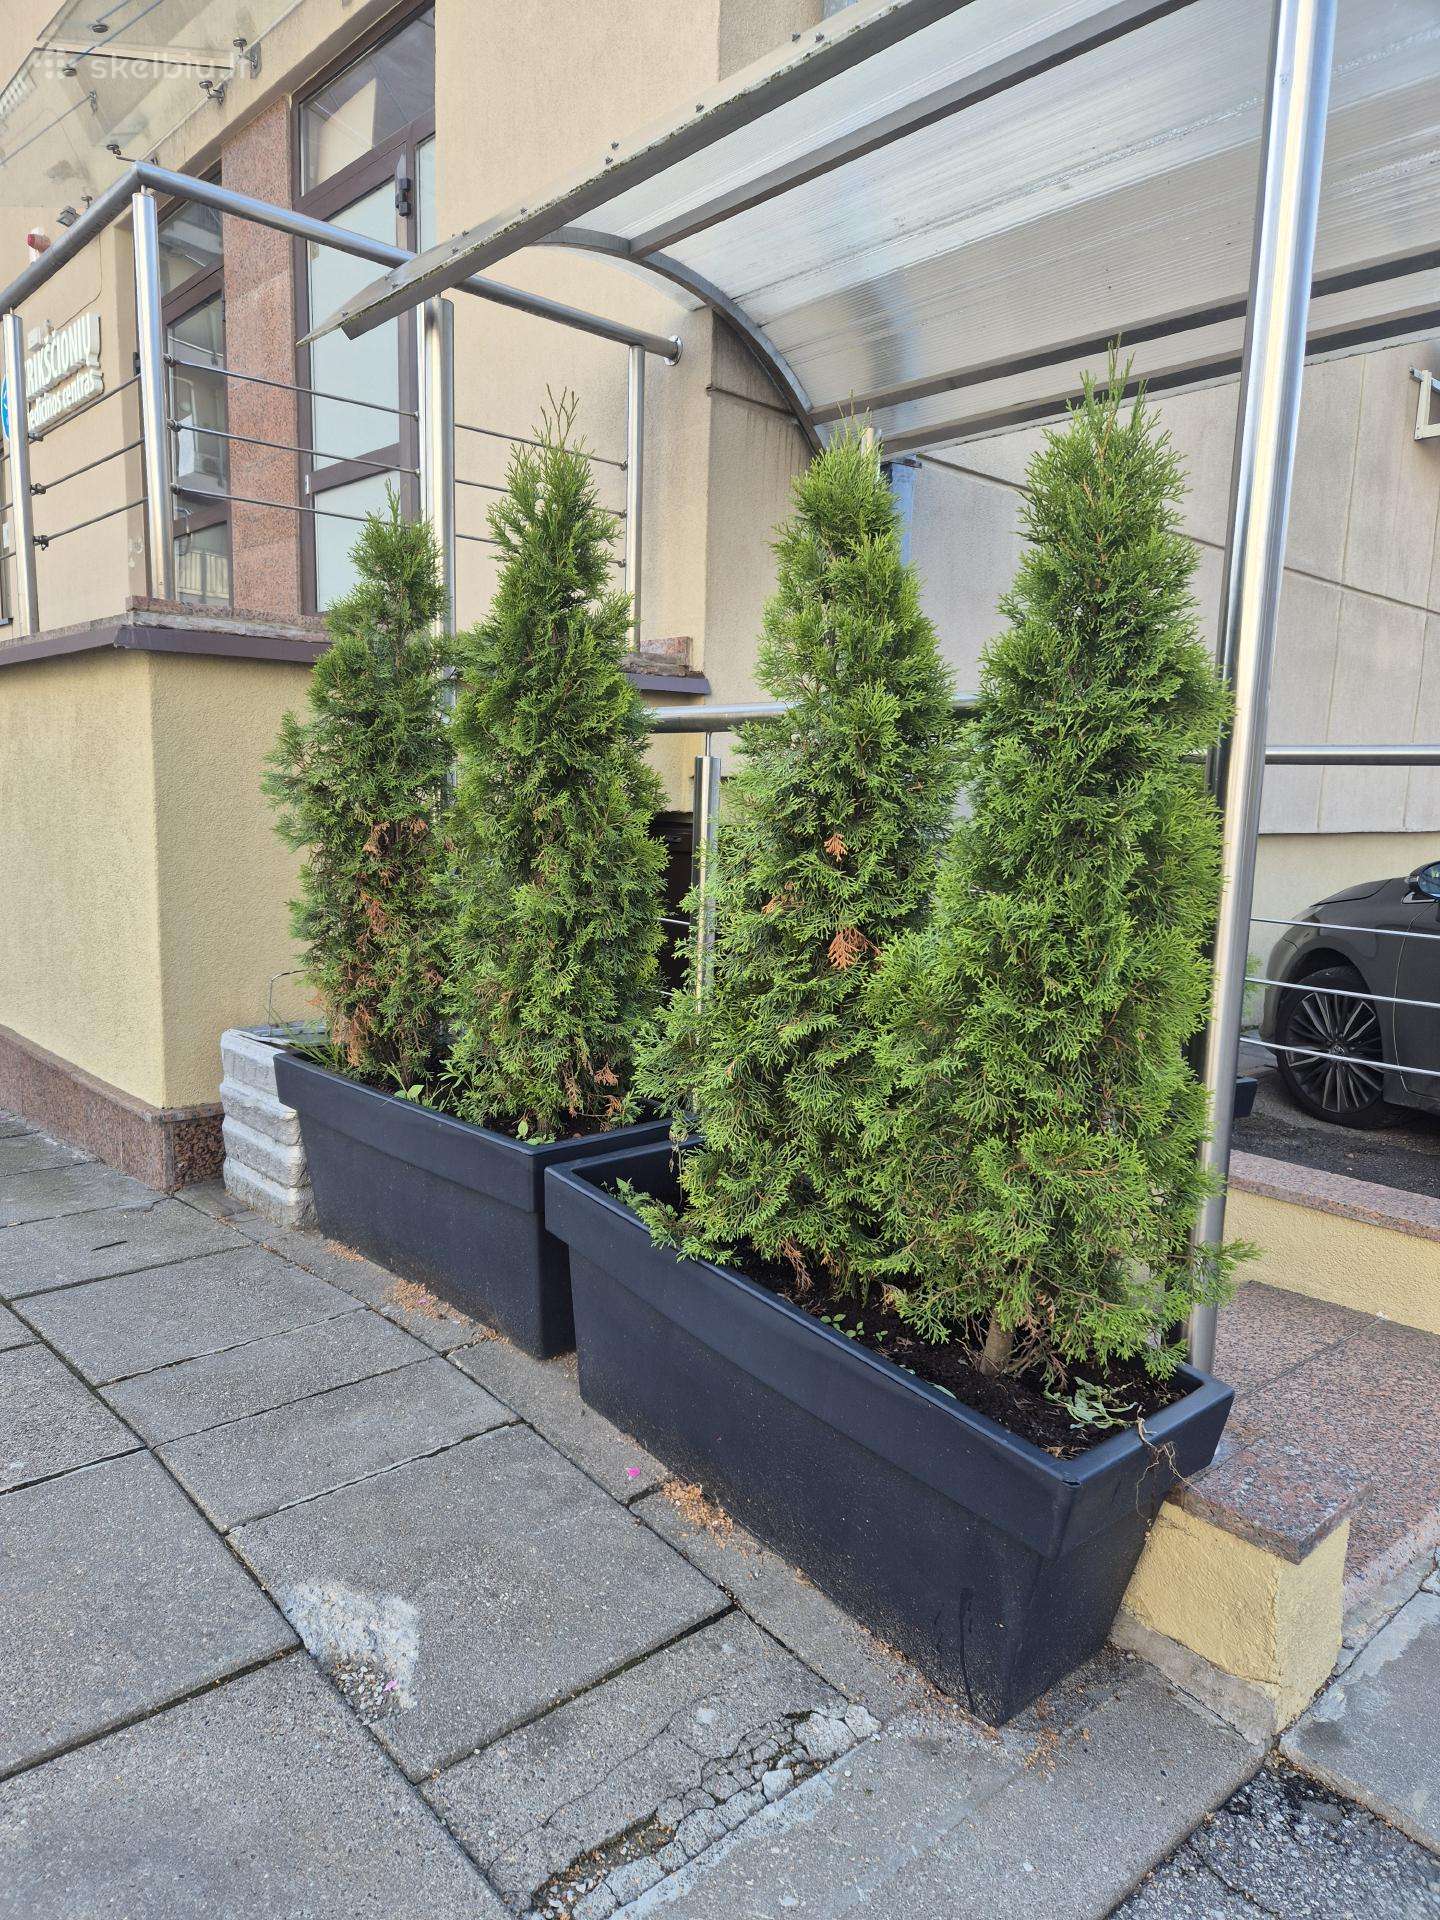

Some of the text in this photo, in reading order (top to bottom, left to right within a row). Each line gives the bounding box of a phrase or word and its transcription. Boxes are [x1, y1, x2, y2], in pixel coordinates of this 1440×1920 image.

[25, 312, 92, 398] RIKŠČIONIŲ
[27, 367, 95, 431] edicinos centras
